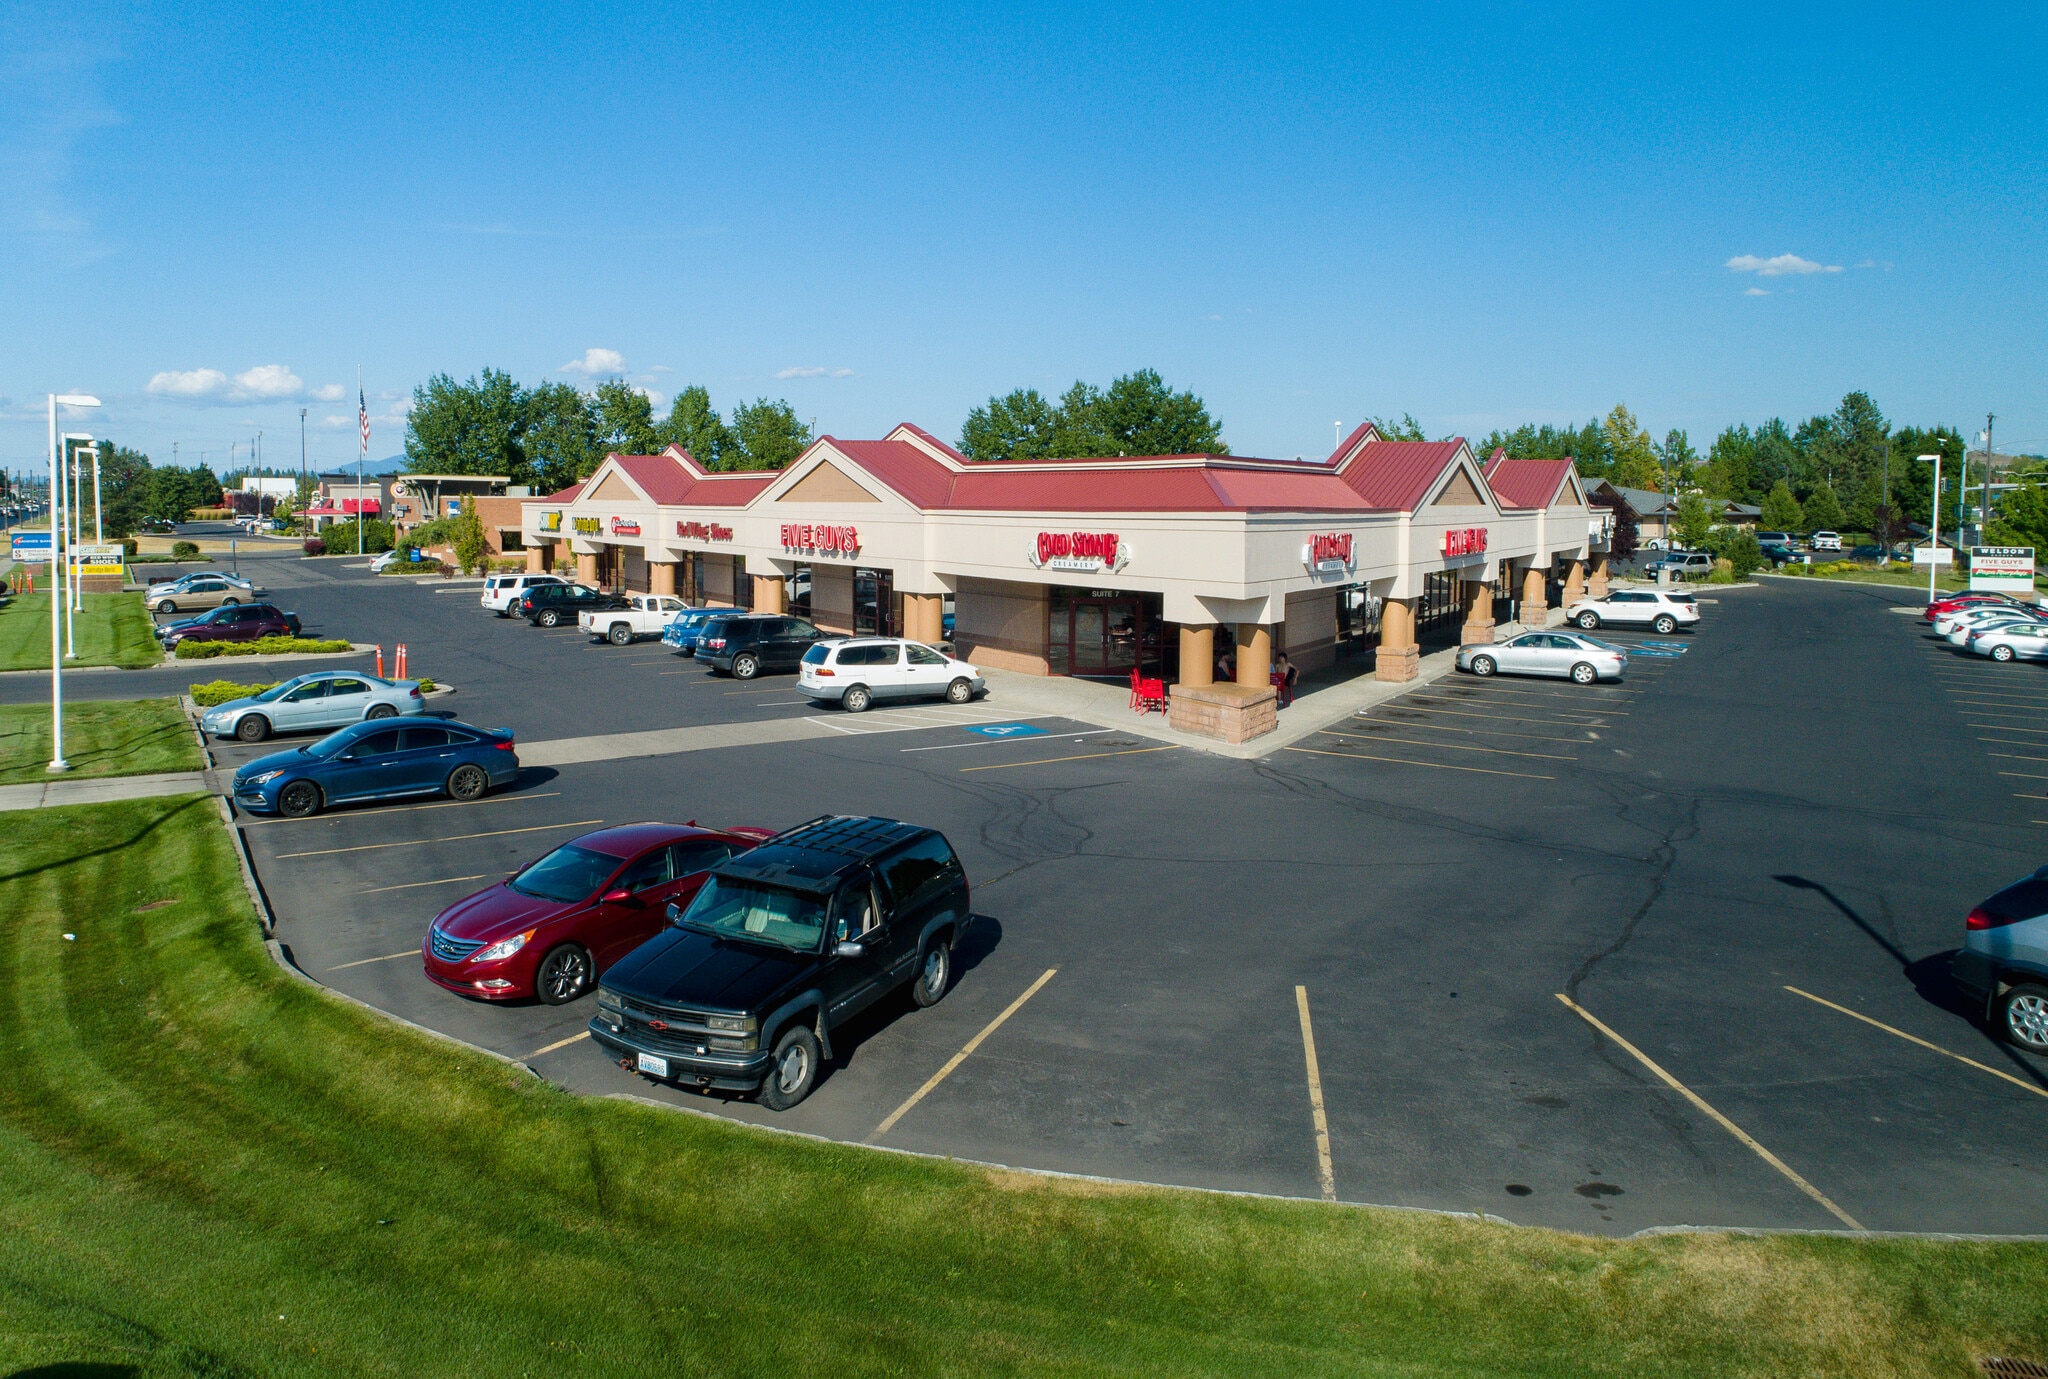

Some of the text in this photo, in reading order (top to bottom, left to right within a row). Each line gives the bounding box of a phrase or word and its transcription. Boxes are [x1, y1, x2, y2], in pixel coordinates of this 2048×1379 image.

[781, 524, 858, 552] FIVE GUYS
[1037, 532, 1118, 565] COLD STONE
[1053, 560, 1094, 568] CREAMERY
[1092, 590, 1112, 598] SUITE
